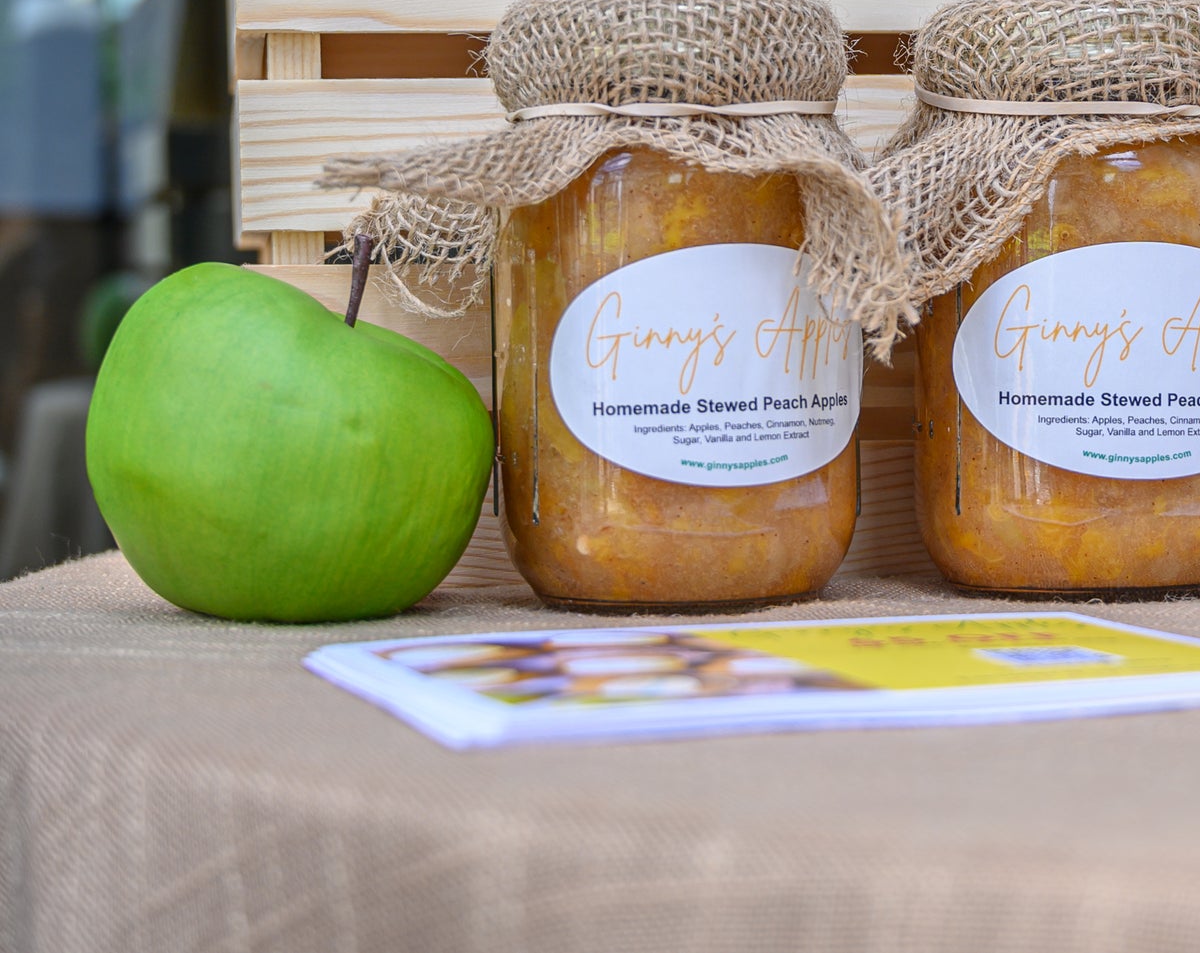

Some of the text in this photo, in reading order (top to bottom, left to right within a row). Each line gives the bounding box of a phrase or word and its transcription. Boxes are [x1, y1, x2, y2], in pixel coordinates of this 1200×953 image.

[586, 291, 736, 395] Ginny's
[994, 284, 1143, 388] Ginny's
[593, 393, 848, 416] Homemade Stewed Peach Apples
[999, 391, 1095, 406] Homemade
[1101, 392, 1162, 407] Stewed
[634, 423, 687, 434] Ingredients:
[689, 423, 721, 433] Apples,
[724, 421, 764, 431] Peaches,
[766, 418, 807, 429] Cinnamon,
[1038, 415, 1090, 424] Ingredients:
[1092, 416, 1125, 425] Apples,
[1128, 416, 1167, 425] Peaches,
[673, 430, 810, 445] Sugar, Vanilla and Lemon Extract
[1076, 428, 1105, 437] Sugar,
[1107, 428, 1136, 436] Vanilla
[1138, 428, 1155, 436] and
[1157, 428, 1185, 436] Lemon
[680, 454, 788, 470] www.ginnysapples.com
[1082, 449, 1192, 464] www.ginnysapples.com
